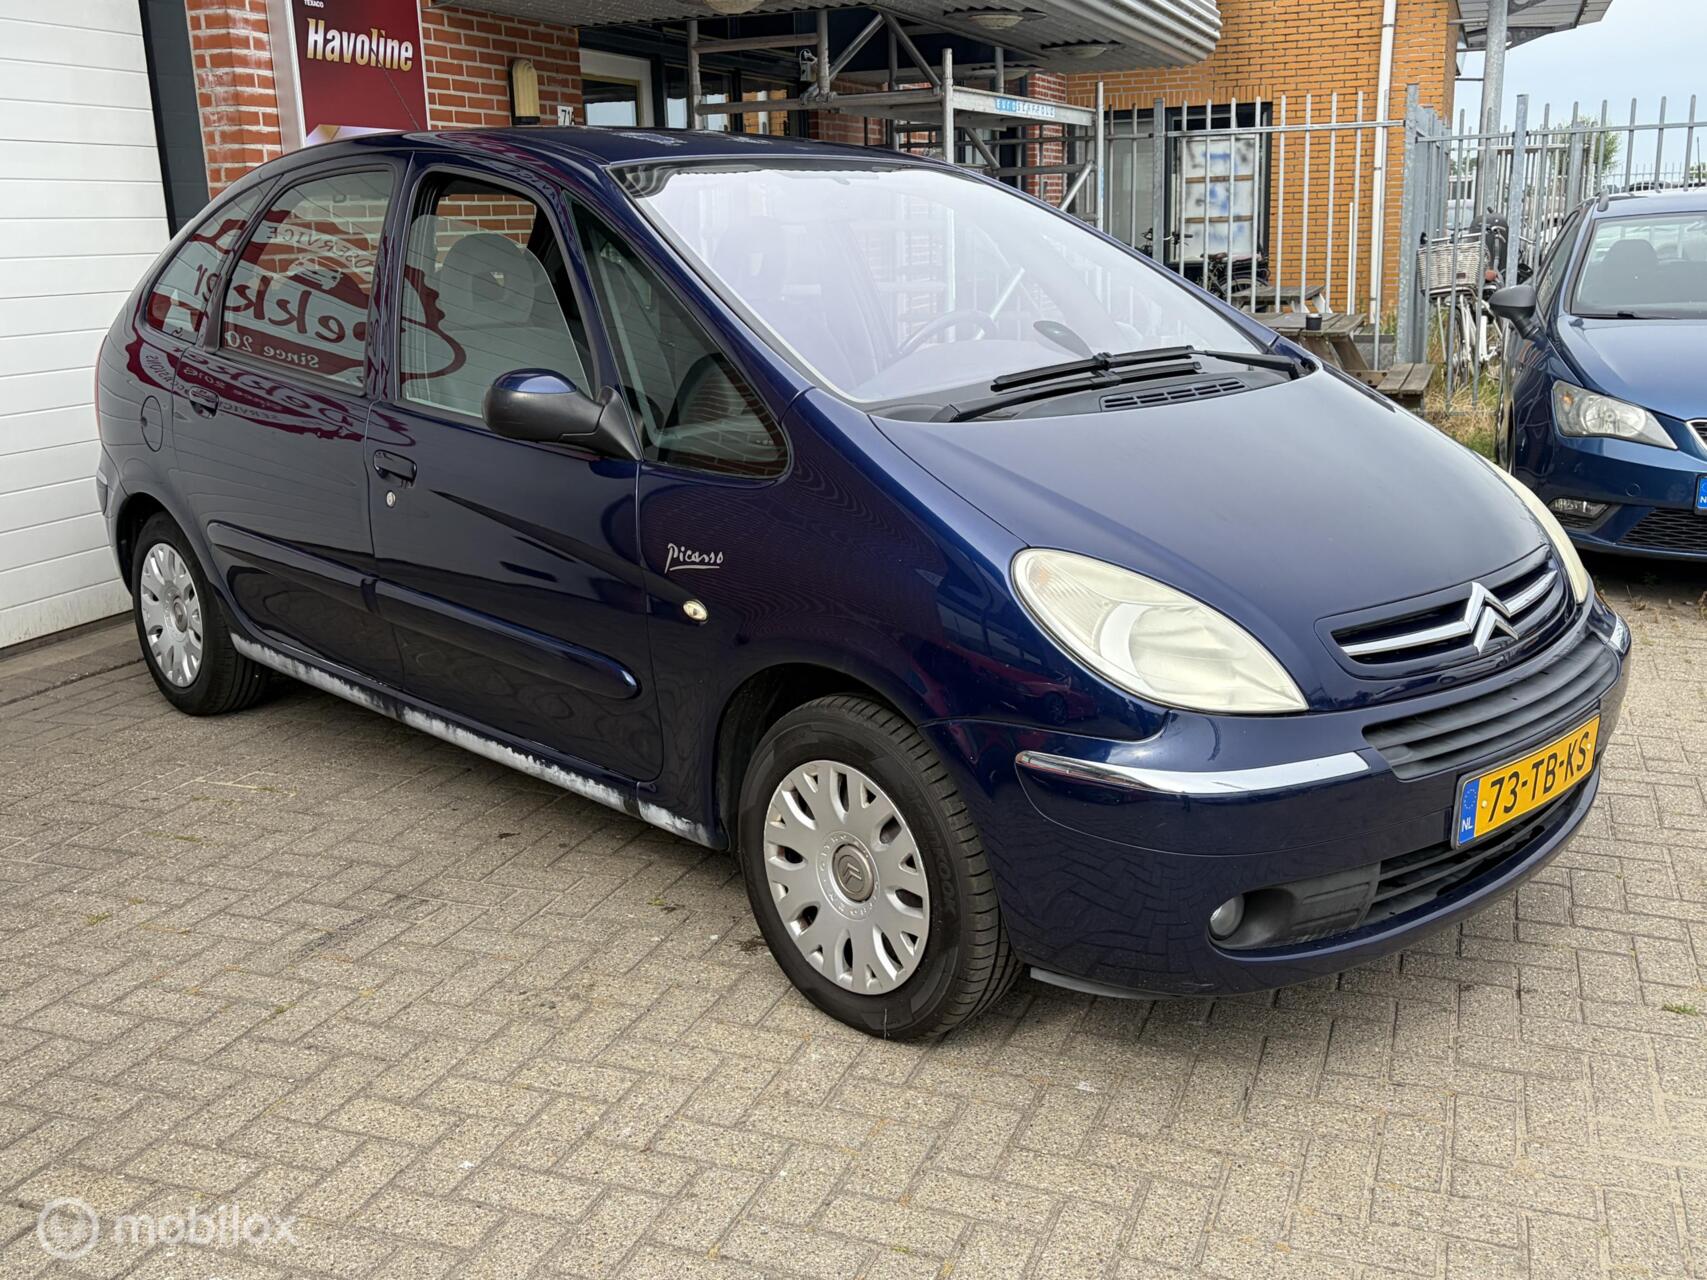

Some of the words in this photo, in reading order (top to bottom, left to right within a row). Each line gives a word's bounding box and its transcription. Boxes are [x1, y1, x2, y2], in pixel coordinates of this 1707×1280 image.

[307, 18, 413, 72] Havoline
[664, 543, 724, 574] Picasso
[1488, 731, 1590, 823] 73-TB-KS
[1461, 816, 1473, 833] NL
